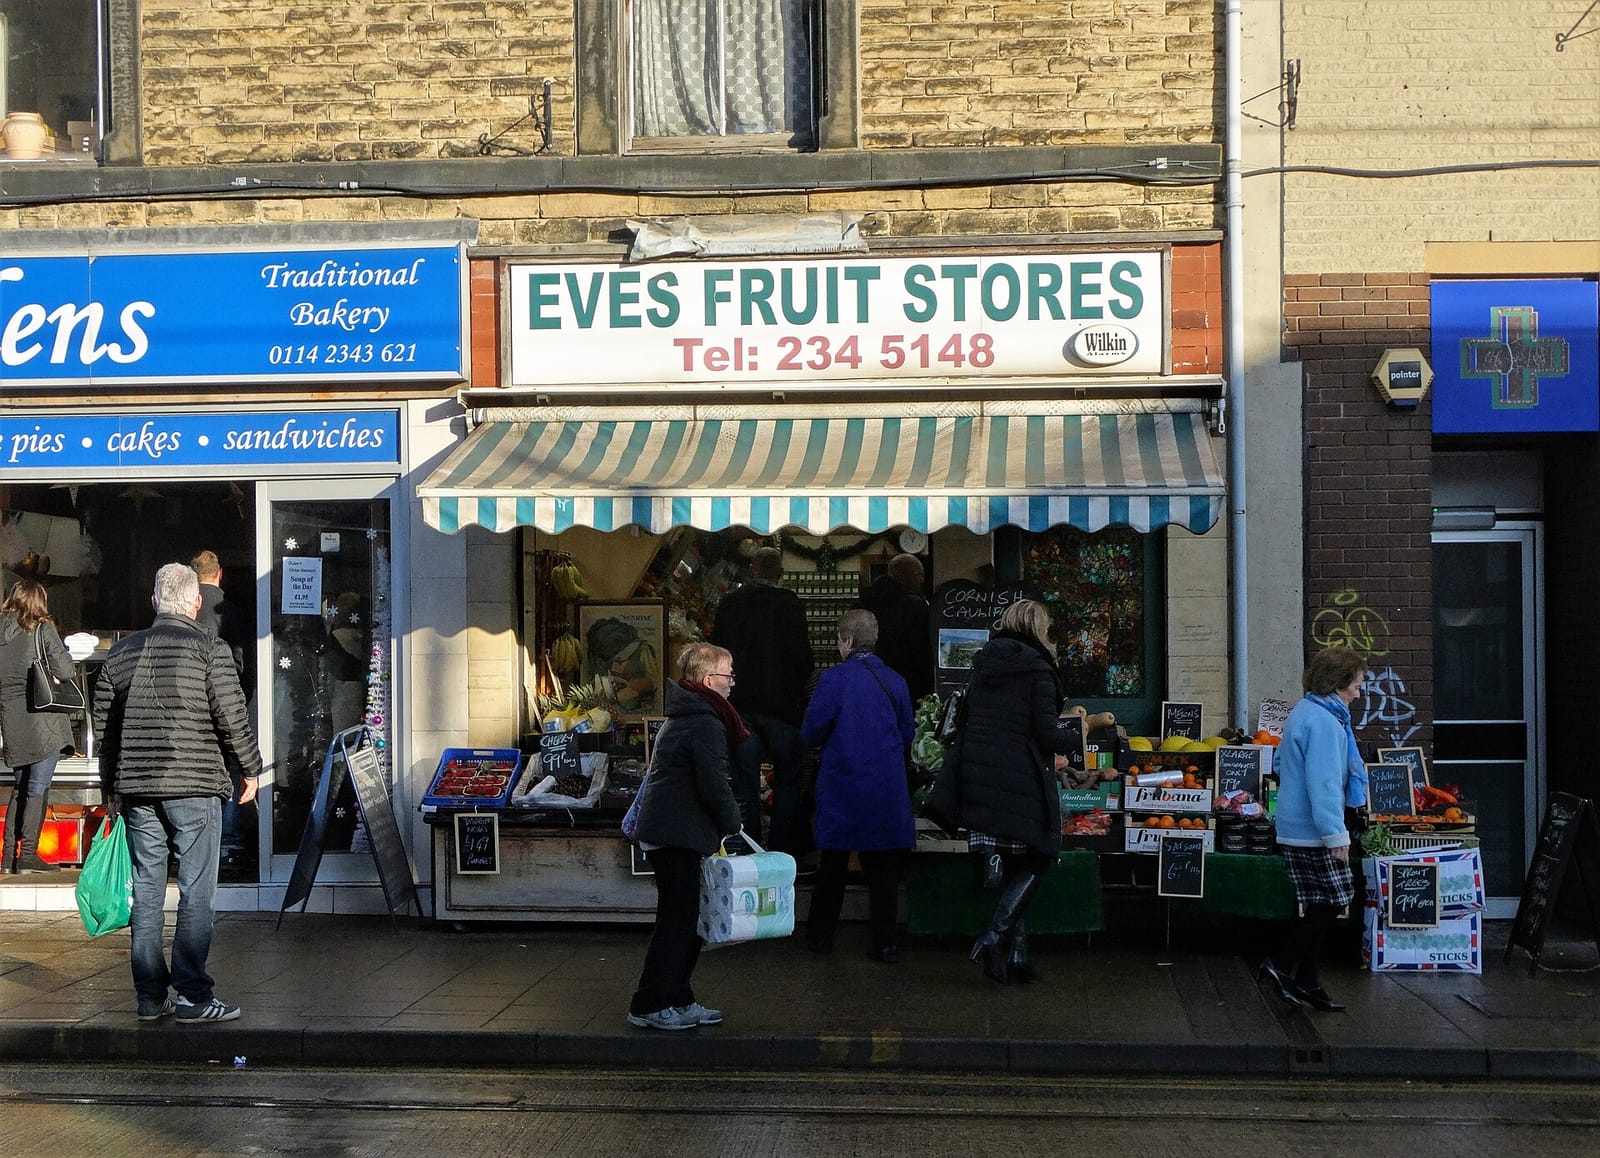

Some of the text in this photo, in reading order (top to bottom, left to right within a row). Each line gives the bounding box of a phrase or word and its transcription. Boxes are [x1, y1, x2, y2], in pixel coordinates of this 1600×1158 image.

[261, 258, 426, 289] Traditional
[528, 260, 1145, 330] EVES FRUIT STORES
[290, 298, 390, 333] Bakery
[1084, 332, 1127, 352] Wilkin
[268, 342, 417, 365] 0114 2343 621
[673, 333, 995, 372] Tel: 234 5148
[1390, 370, 1420, 381] pointer
[7, 425, 66, 463] pies
[106, 421, 182, 458] cakes
[222, 417, 385, 450] sandwiches
[290, 575, 314, 584] Soup of
[302, 583, 313, 592] Day
[944, 588, 1024, 605] CORNISH
[1396, 867, 1431, 879] SPROUT
[1440, 892, 1474, 904] TICKS
[1429, 952, 1468, 962] STICKS
